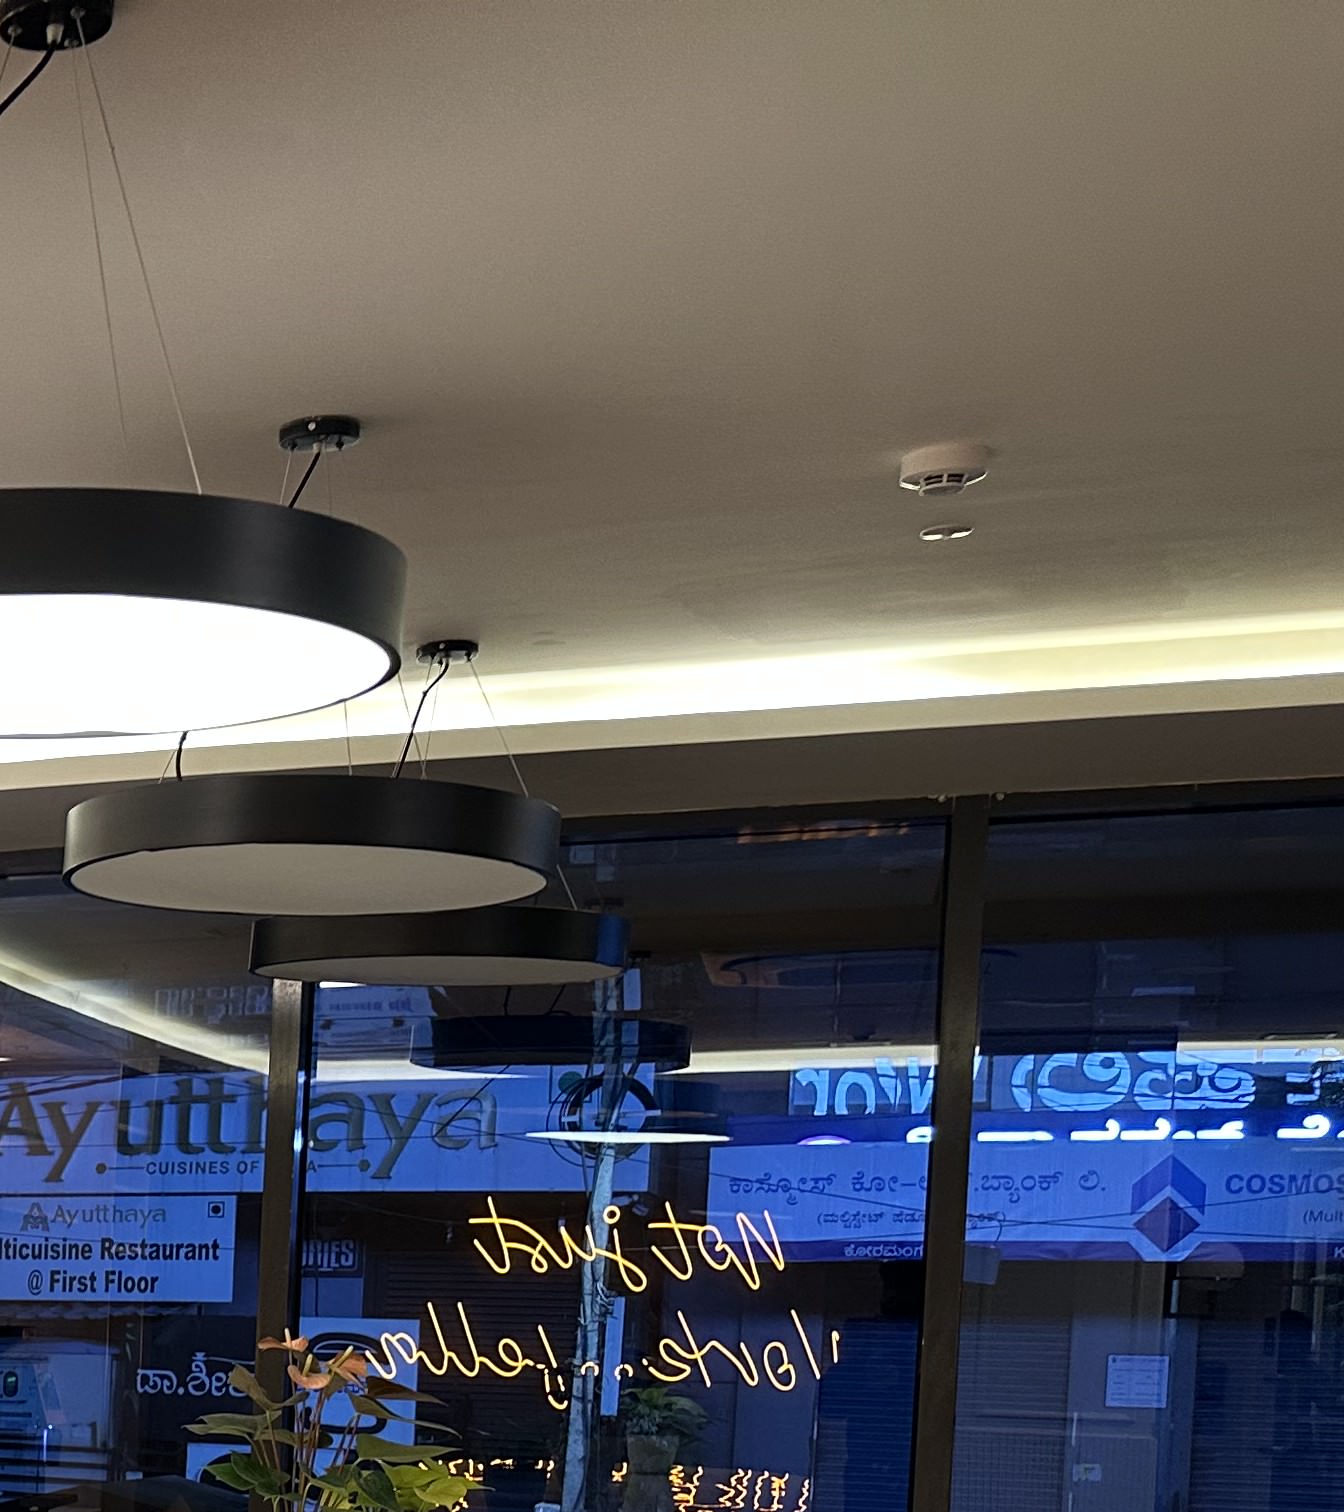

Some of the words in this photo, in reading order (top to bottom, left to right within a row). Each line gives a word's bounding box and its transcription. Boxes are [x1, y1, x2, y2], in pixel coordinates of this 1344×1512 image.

[145, 1160, 230, 1175] CUISINES
[236, 1160, 259, 1175] OF
[51, 1205, 167, 1228] Ayutthaya
[100, 1236, 220, 1261] Restaurant
[27, 1269, 44, 1296] @
[49, 1269, 97, 1293] First
[104, 1269, 160, 1293] Floor
